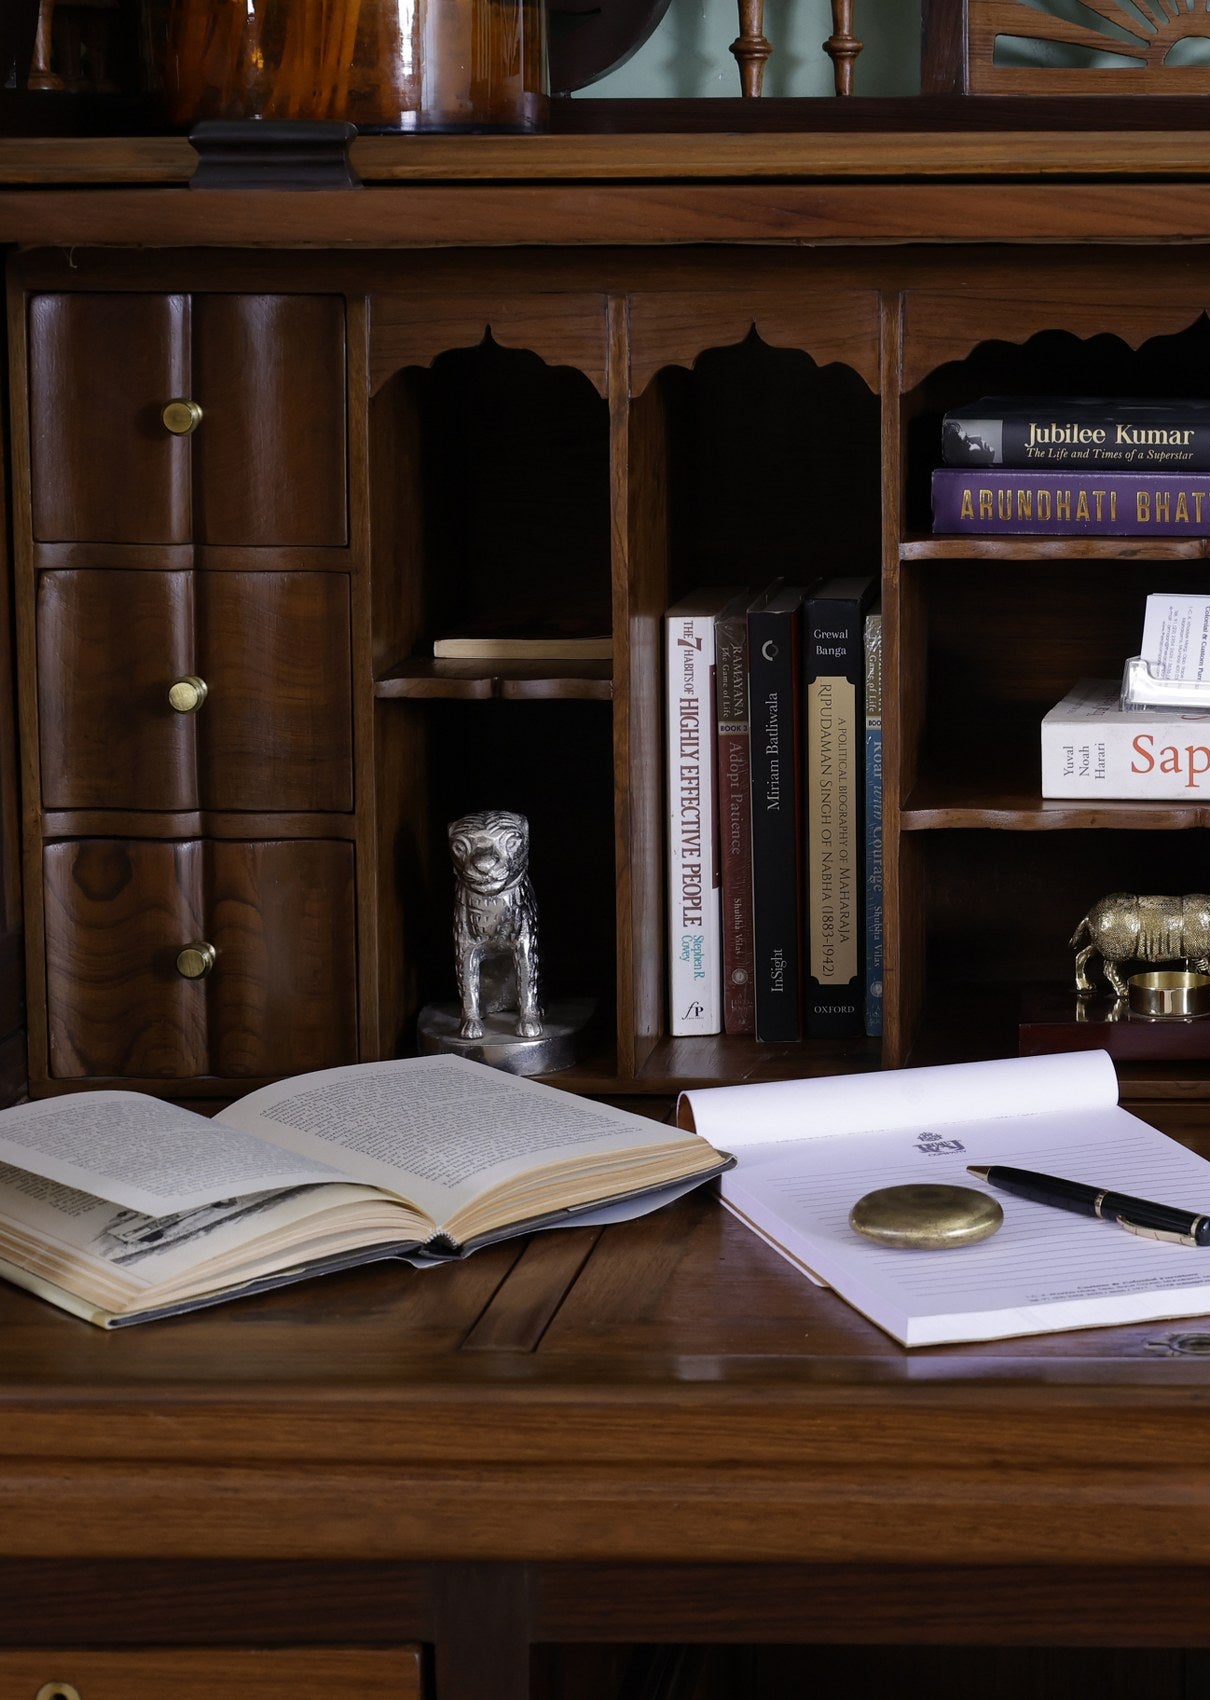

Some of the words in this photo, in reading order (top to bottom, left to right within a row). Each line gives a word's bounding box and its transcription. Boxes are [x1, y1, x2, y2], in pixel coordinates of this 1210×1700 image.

[1024, 423, 1106, 448] Jubilee
[1115, 424, 1195, 446] Kumar
[1027, 447, 1045, 458] The
[1048, 447, 1068, 461] Life
[1070, 449, 1089, 459] and
[1093, 449, 1122, 459] Times
[1125, 449, 1136, 462] of
[1146, 449, 1194, 462] Superstar
[960, 488, 1117, 522] ARUNDHATI
[683, 620, 694, 639] THE
[813, 629, 848, 639] Grewal
[1202, 605, 1210, 632] Colonial
[677, 637, 703, 652] 7
[816, 645, 847, 657] Banga
[1202, 633, 1208, 641] &
[684, 649, 694, 682] HABITS
[1199, 641, 1207, 667] Custom
[684, 683, 694, 695] OF
[722, 664, 730, 688] Game
[731, 645, 743, 717] RAMAYANA
[870, 681, 877, 693] of
[723, 689, 730, 699] of
[869, 694, 877, 713] Life
[680, 697, 700, 761] HIGHLY
[765, 692, 778, 756] Batliwala
[818, 684, 832, 775] RIPUDAMAN
[838, 717, 846, 726] A
[727, 742, 743, 788] Adopt
[838, 728, 847, 783] POLITICAL
[1063, 745, 1074, 777] Yuval
[1079, 745, 1090, 777] Noah
[1094, 742, 1106, 780] Harari
[767, 760, 780, 811] Miriam
[680, 765, 701, 859] EFFECTIVE
[820, 780, 832, 825] SINGH
[839, 785, 848, 847] BIOGRAPHY
[730, 794, 743, 855] Patience
[821, 828, 832, 848] OF
[839, 849, 848, 863] OF
[870, 825, 883, 892] Courage
[821, 852, 833, 901] NABHA
[682, 863, 702, 928] PEOPLE
[838, 867, 850, 943] MAHARAJA
[734, 898, 743, 930] Shubha
[874, 905, 882, 940] Shubha
[680, 934, 693, 962] Covey
[694, 934, 706, 971] Stephen
[822, 905, 835, 977] (1883-1942)
[874, 944, 883, 967] Vilas
[694, 971, 705, 981] R.
[771, 948, 787, 992] InSight
